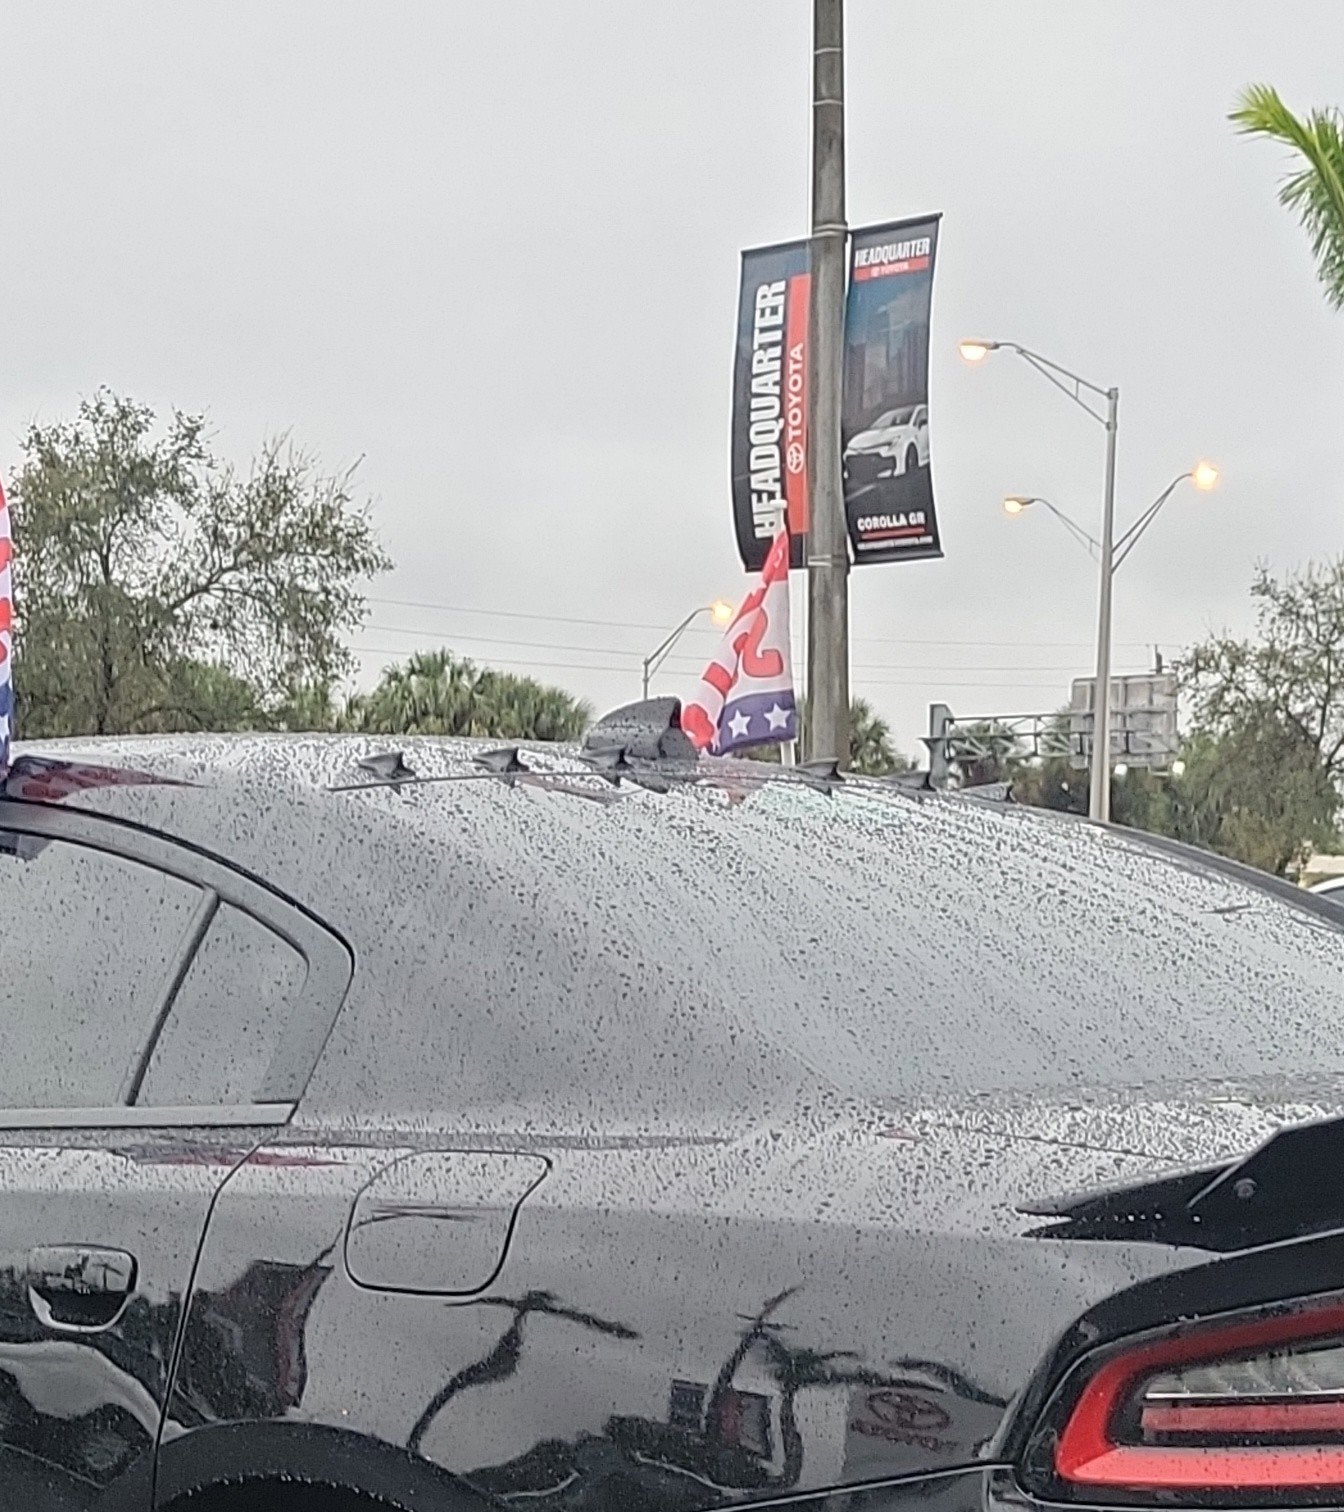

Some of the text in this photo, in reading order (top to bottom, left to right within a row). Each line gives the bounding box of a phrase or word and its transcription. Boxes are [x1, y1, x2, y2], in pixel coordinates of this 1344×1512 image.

[855, 237, 931, 268] HEADQUARTER
[750, 279, 786, 538] HEADQUARTER
[788, 343, 803, 442] TOYOTA
[857, 513, 908, 531] COROLLA
